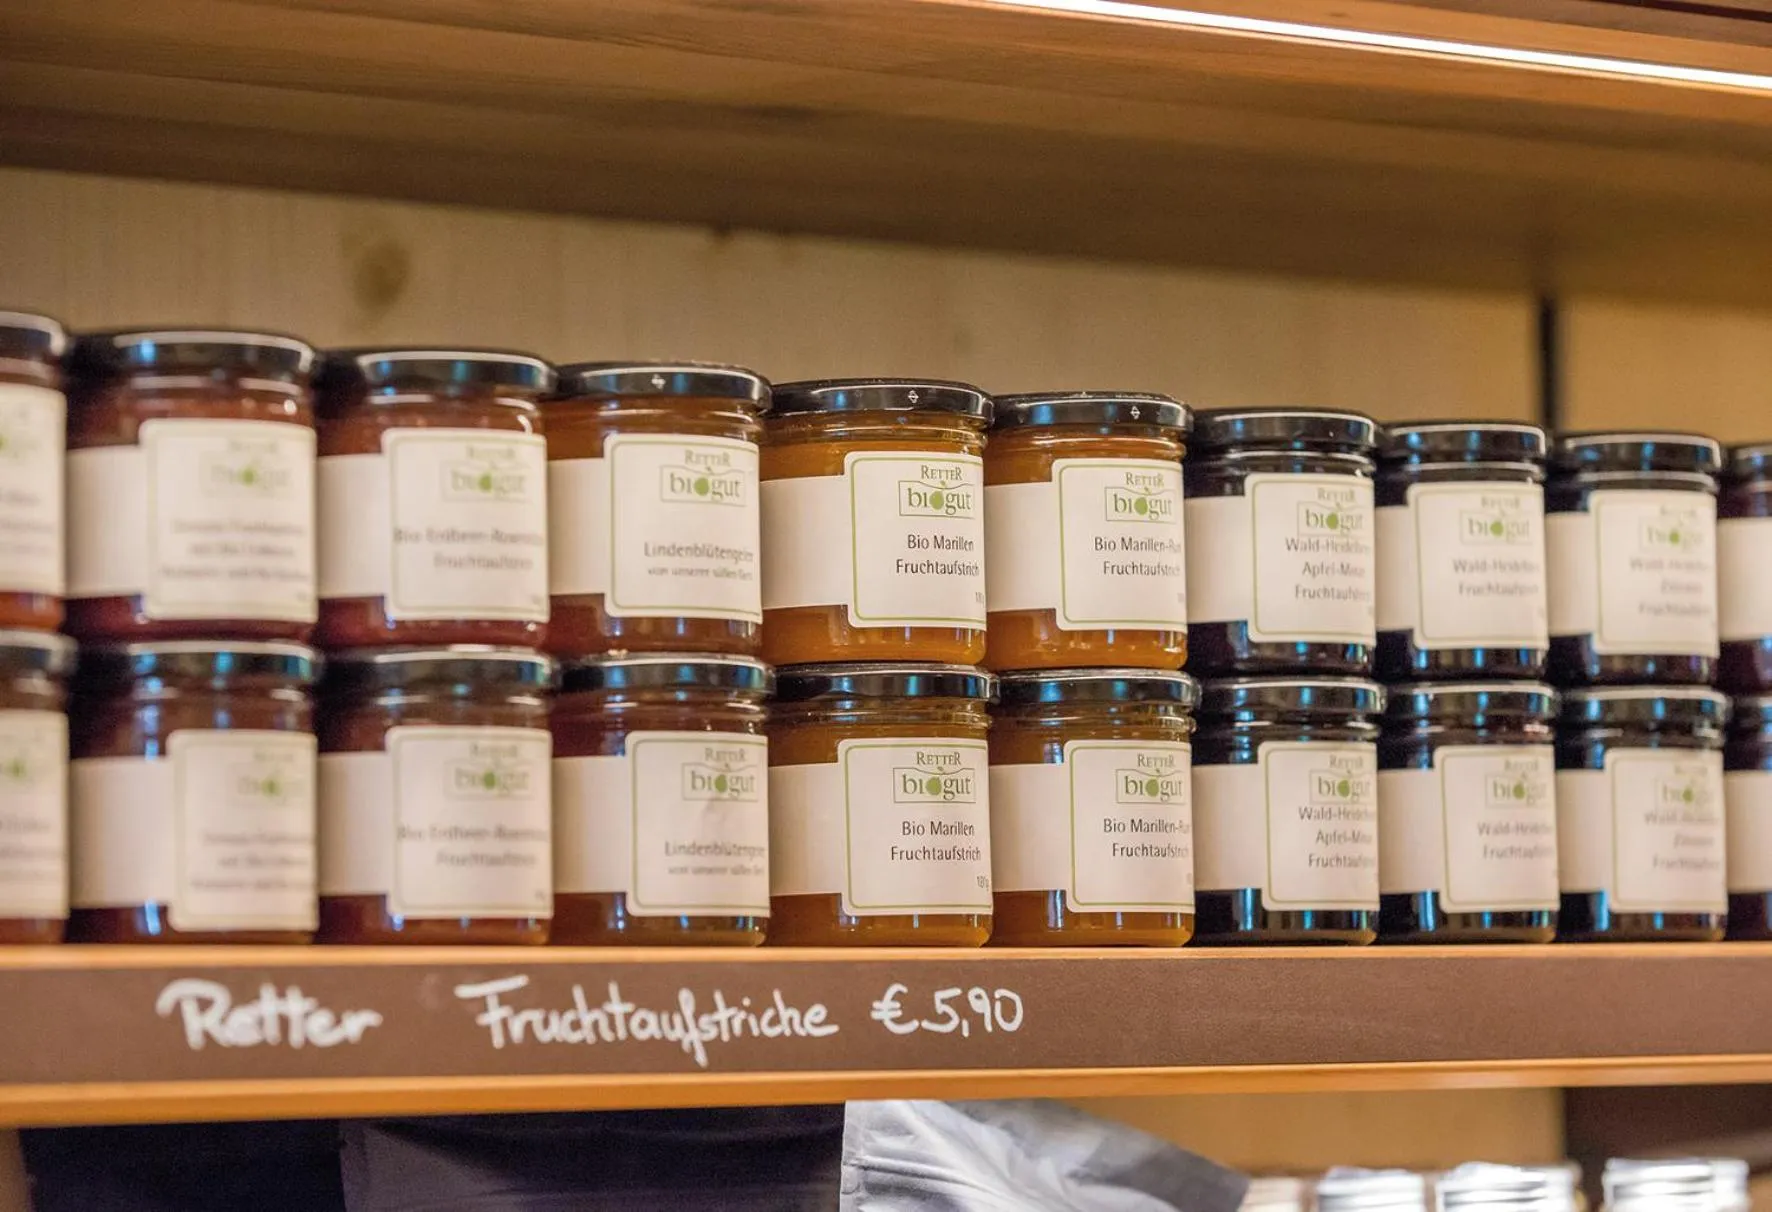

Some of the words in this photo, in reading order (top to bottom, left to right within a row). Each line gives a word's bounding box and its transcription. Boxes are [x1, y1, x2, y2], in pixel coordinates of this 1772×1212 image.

[921, 465, 962, 480] RETTER
[670, 473, 740, 499] biogut
[908, 487, 971, 515] biogut
[1114, 494, 1172, 521] biogut
[1306, 509, 1363, 535] biogut
[907, 534, 930, 549] Bio
[933, 535, 974, 551] Marillen
[1094, 536, 1116, 552] Bio
[896, 559, 979, 577] Fruchtaufstrich
[917, 751, 961, 766] RETTER
[691, 770, 755, 797] biogut
[903, 774, 971, 801] biogut
[1125, 776, 1183, 803] biogut
[902, 820, 925, 836] Bio
[930, 820, 975, 836] Marillen
[1104, 818, 1126, 833] Bio
[891, 846, 981, 861] Fruchtaufstrich
[156, 977, 383, 1050] Retter
[454, 975, 839, 1067] Fruchtaufstriche
